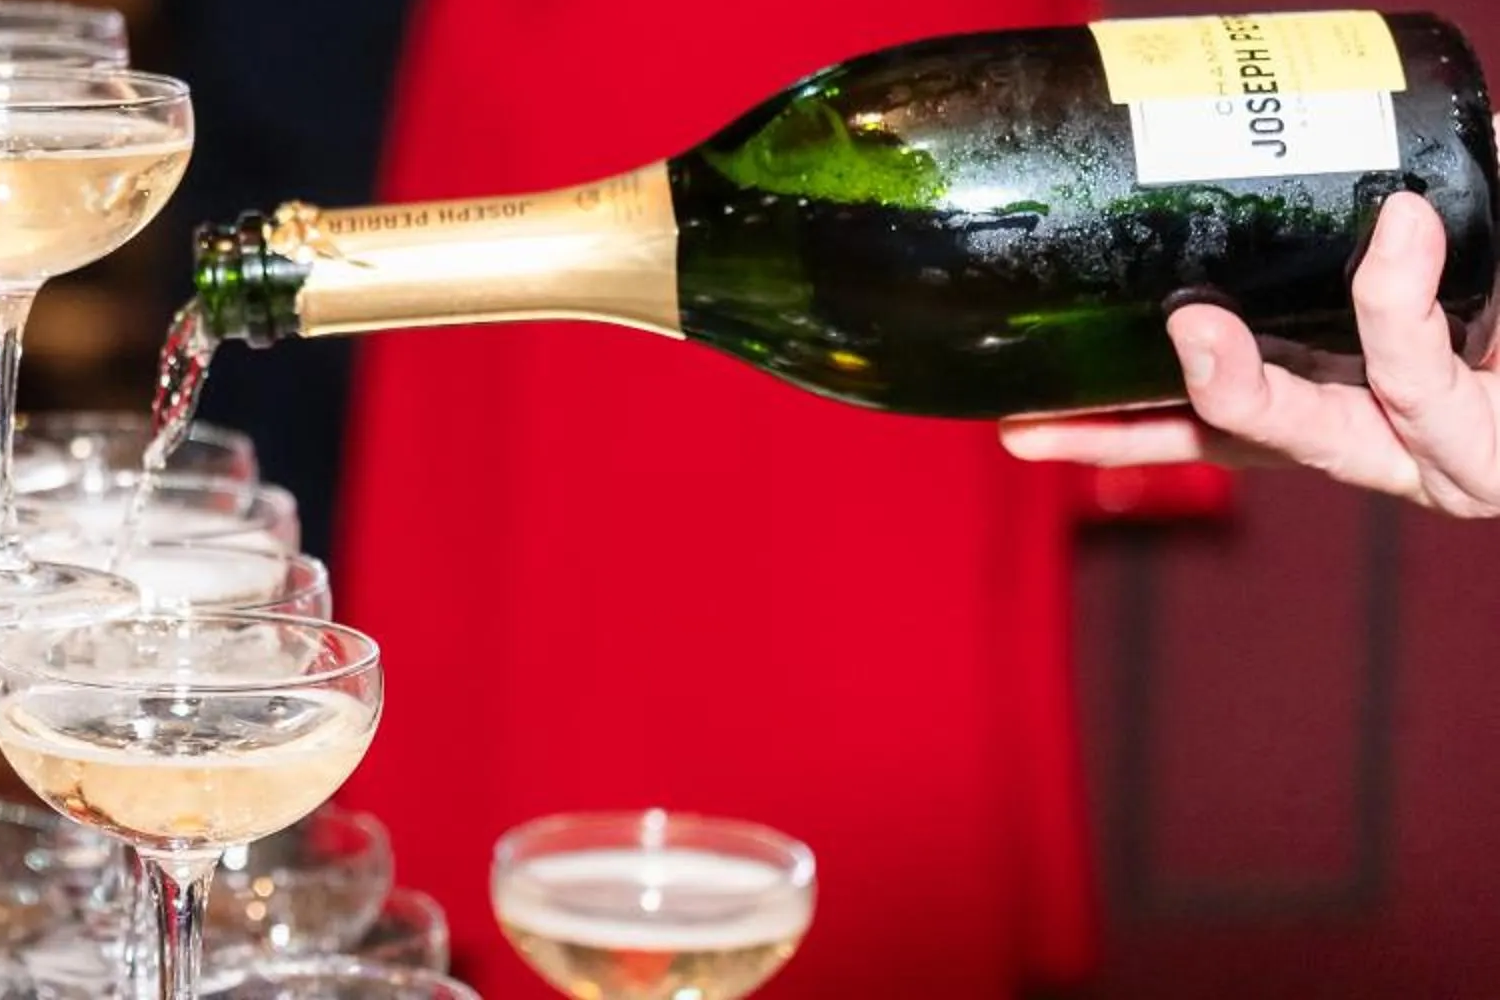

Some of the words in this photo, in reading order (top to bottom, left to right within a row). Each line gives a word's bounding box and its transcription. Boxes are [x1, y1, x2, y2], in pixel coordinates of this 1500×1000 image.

[1235, 49, 1287, 158] JOSEPH
[328, 211, 428, 234] PERRIER
[437, 199, 533, 224] JOSEPH
